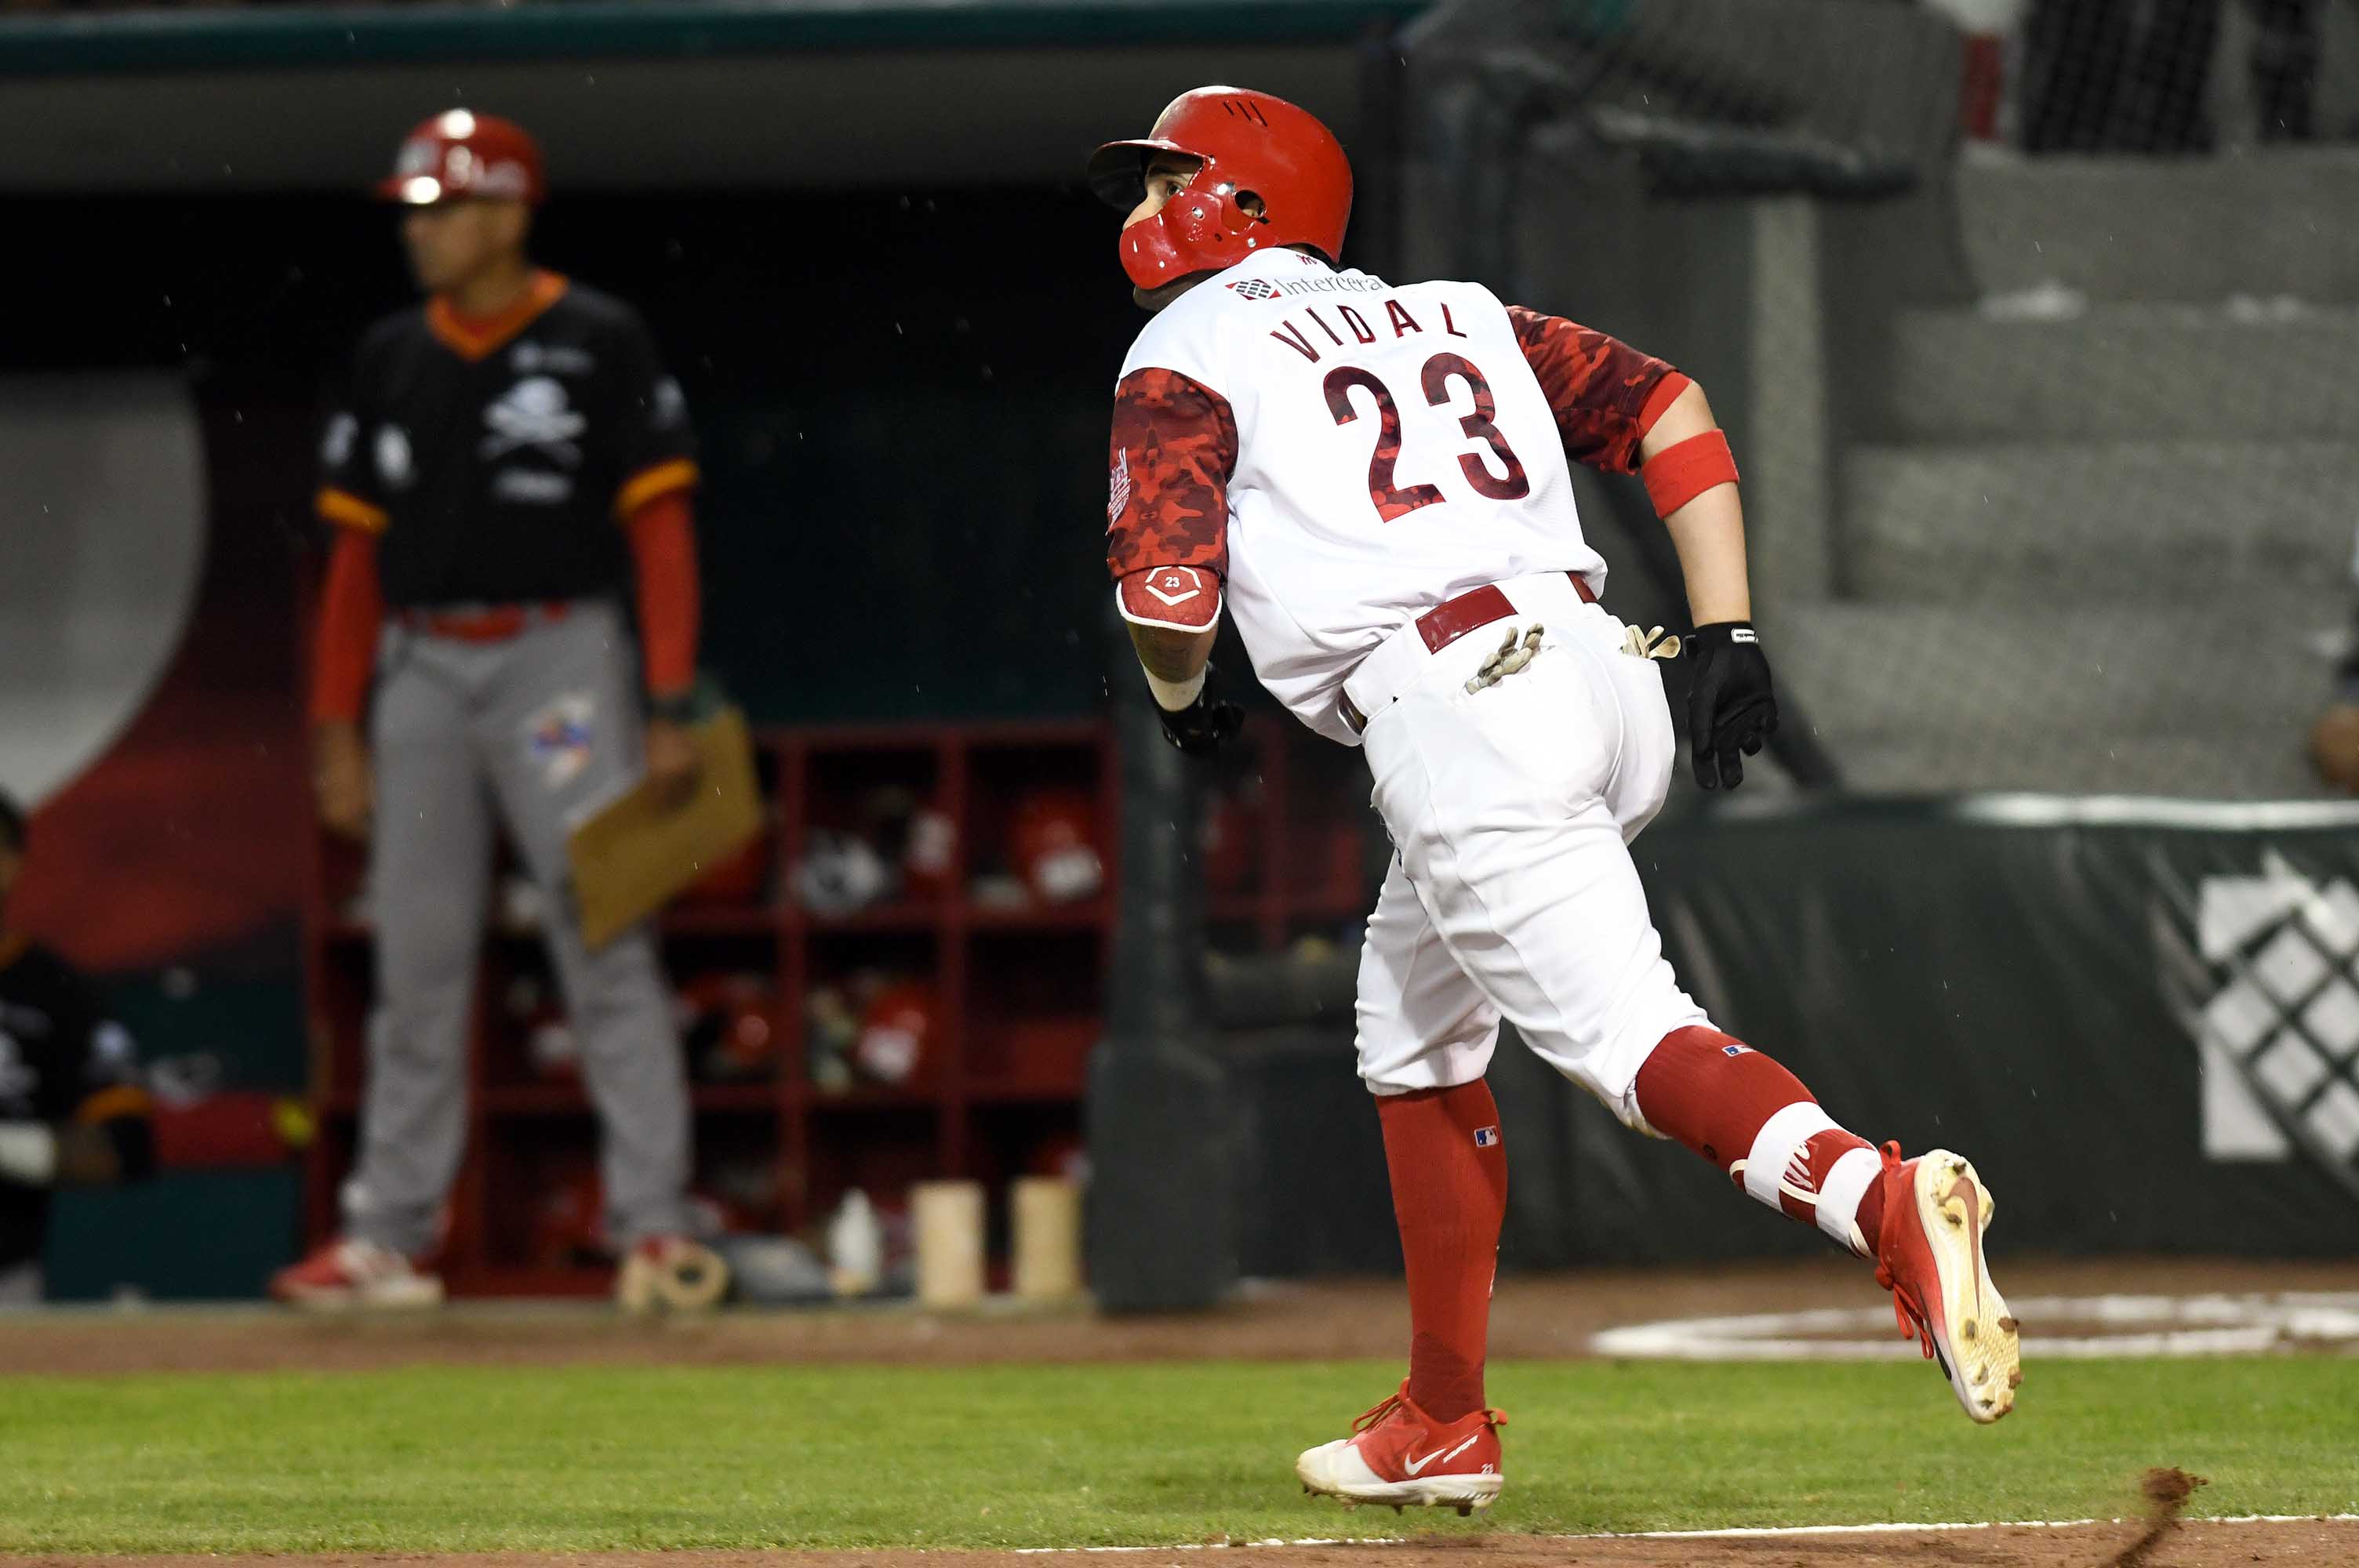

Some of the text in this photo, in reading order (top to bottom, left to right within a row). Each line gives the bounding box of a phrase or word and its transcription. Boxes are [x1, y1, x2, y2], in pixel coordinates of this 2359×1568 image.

[1270, 299, 1467, 363] VIDAL
[1323, 352, 1529, 523] 23
[1165, 576, 1180, 588] 23
